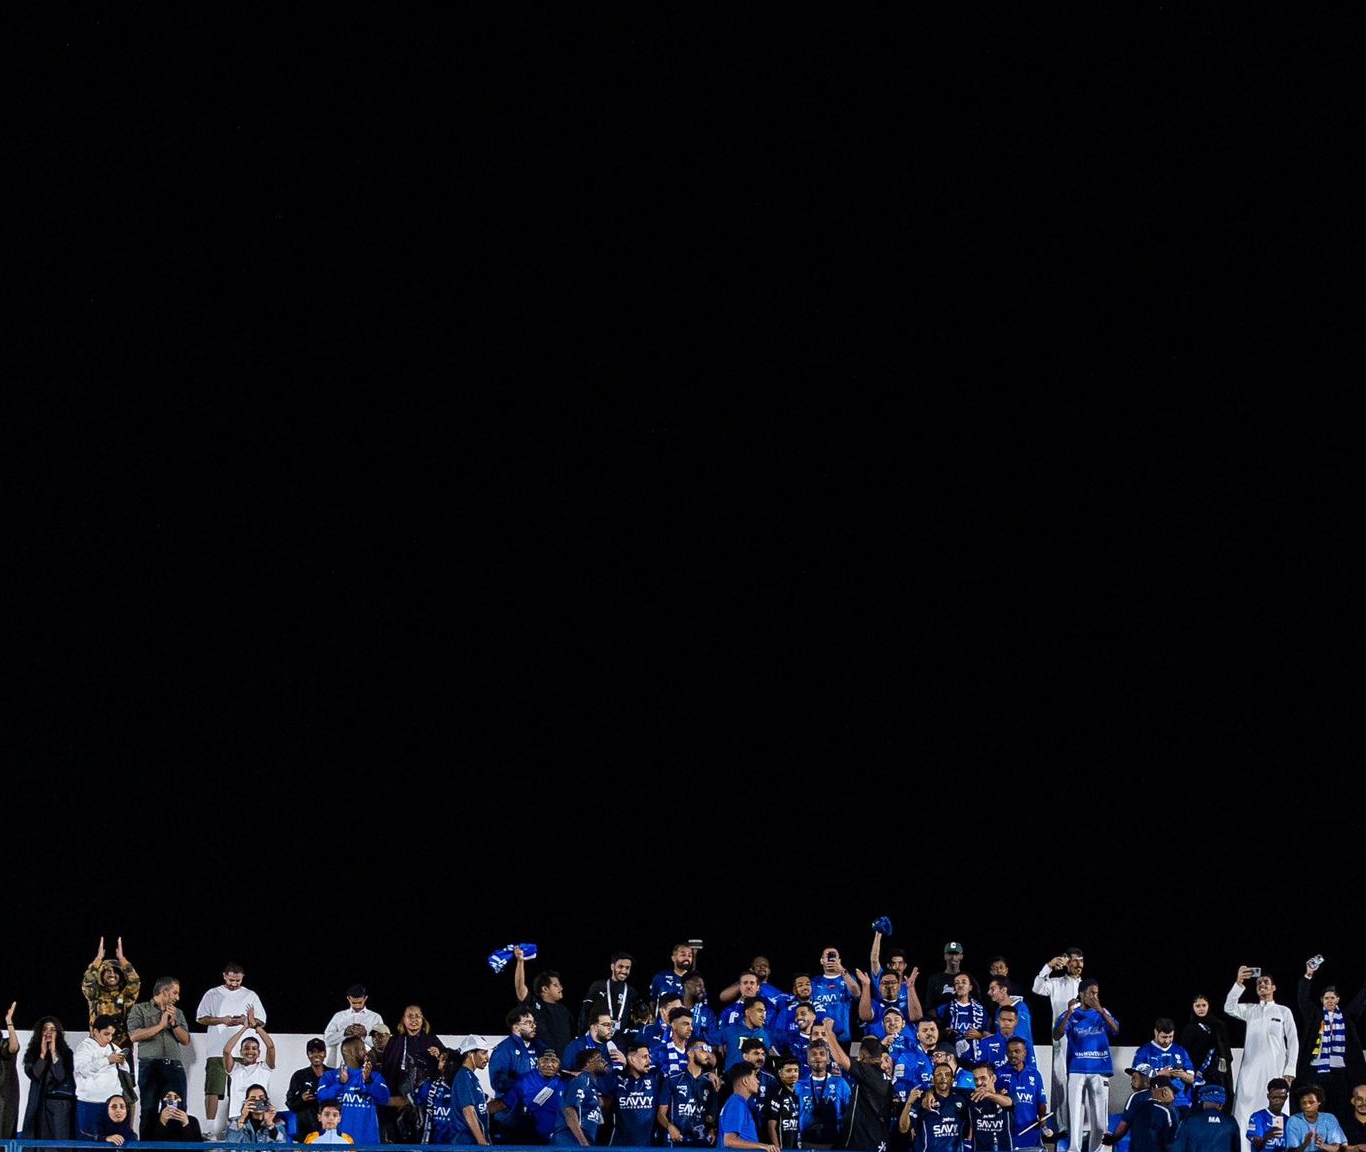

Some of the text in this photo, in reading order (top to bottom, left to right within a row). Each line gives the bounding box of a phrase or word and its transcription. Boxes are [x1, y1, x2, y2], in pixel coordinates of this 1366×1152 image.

[619, 1096, 654, 1107] SAVVY
[976, 1119, 1004, 1129] SAVVY
[1208, 1116, 1222, 1124] MA
